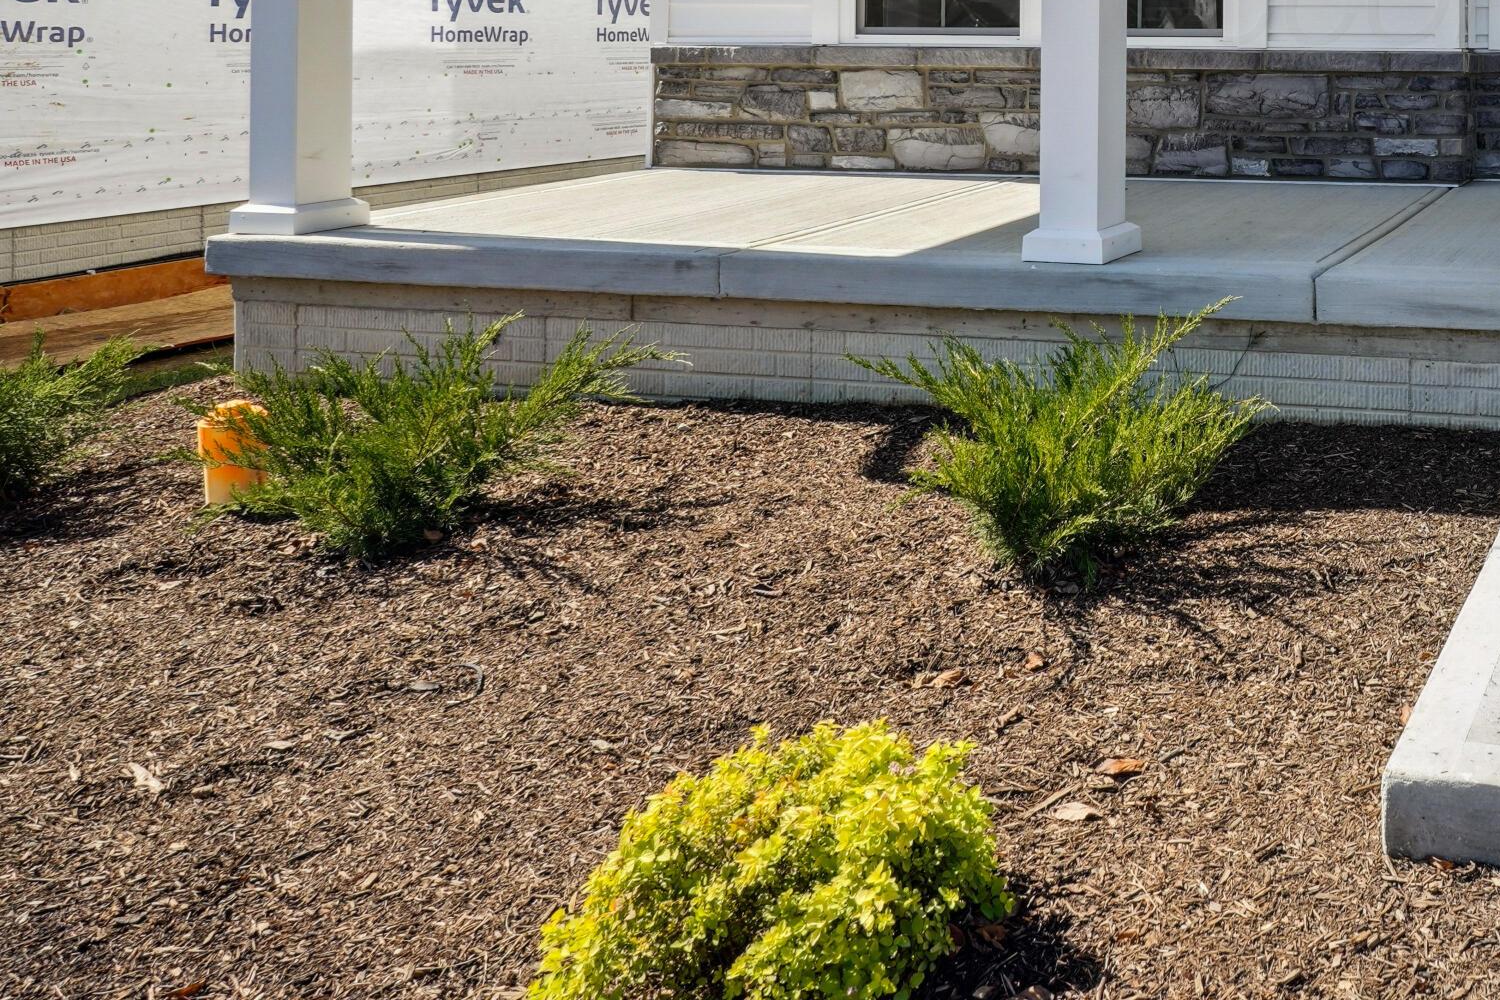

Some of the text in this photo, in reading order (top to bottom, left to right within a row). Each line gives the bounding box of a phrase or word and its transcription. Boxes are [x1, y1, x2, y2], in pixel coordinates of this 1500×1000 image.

[431, 26, 529, 46] HomeWrap
[20, 79, 37, 87] USA
[4, 158, 31, 167] MADE
[43, 156, 59, 165] THE
[60, 155, 77, 163] USA
